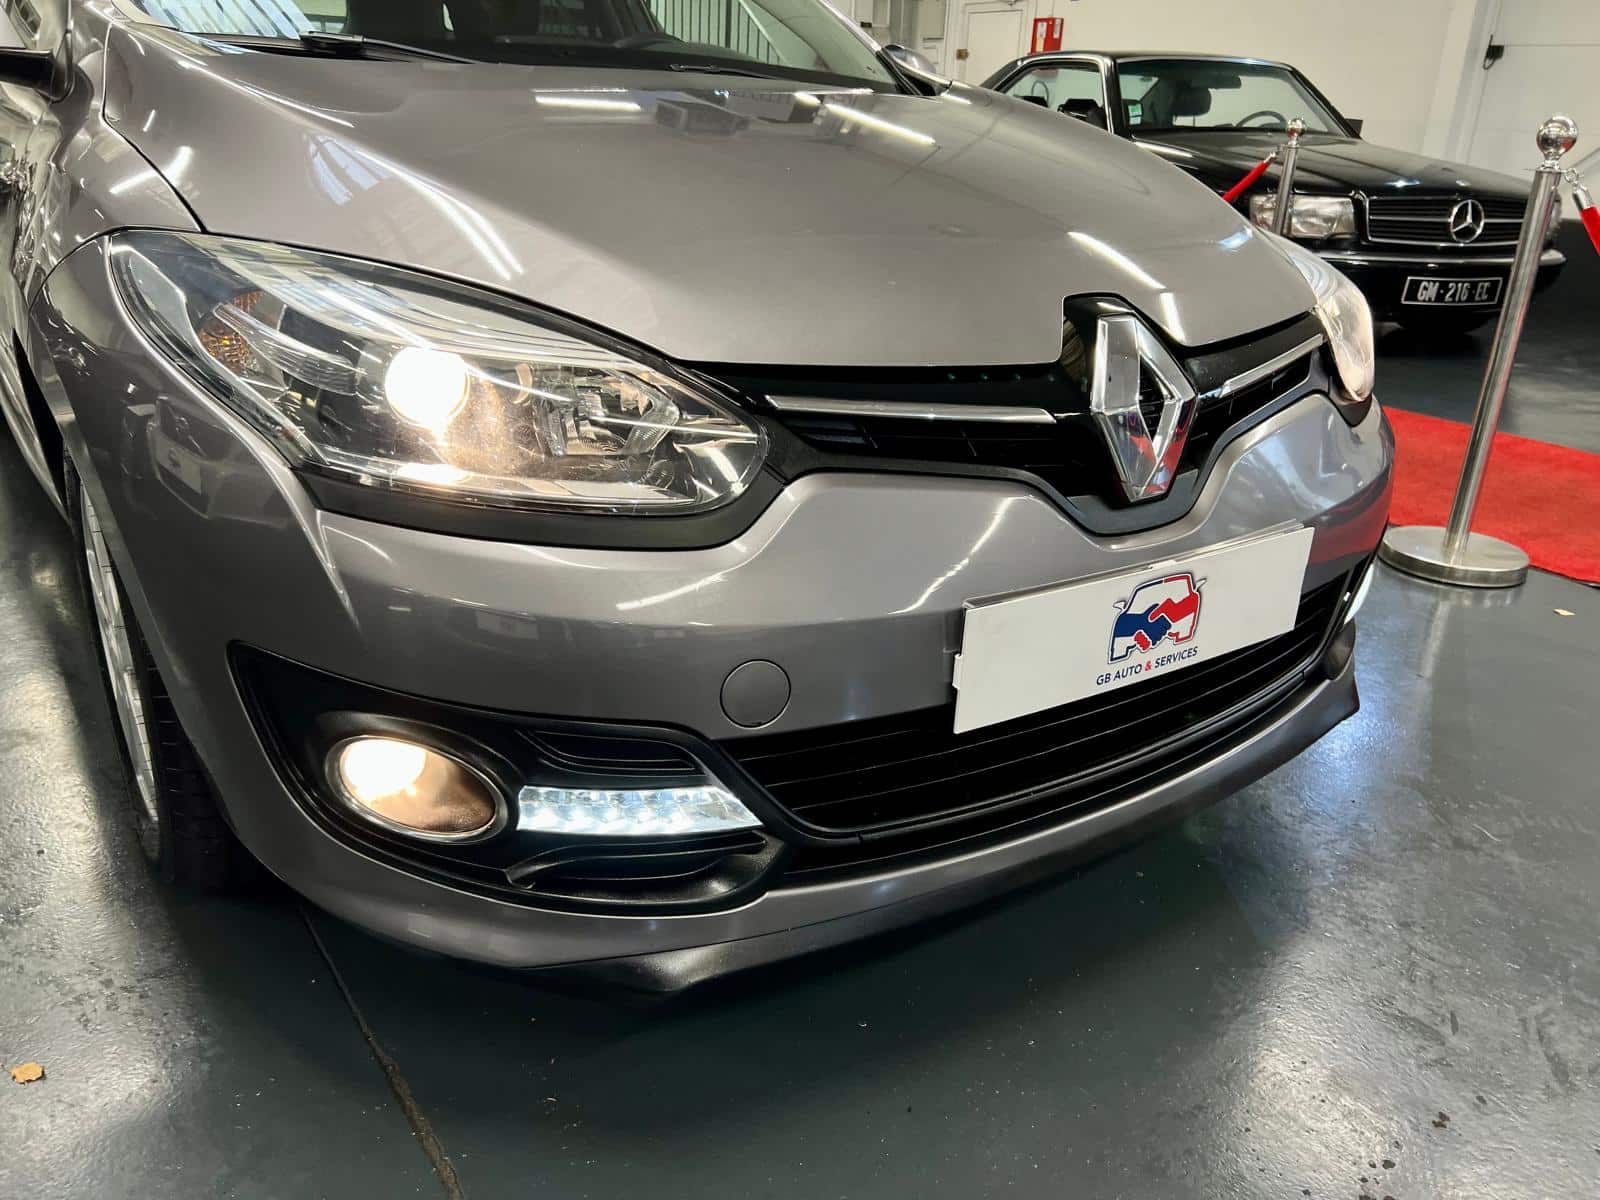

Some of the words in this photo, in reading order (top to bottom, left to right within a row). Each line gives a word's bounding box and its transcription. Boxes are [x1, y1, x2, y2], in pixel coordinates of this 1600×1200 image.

[1096, 673, 1111, 686] GB
[1113, 664, 1143, 681] AUTO
[1144, 660, 1152, 672] &
[1154, 646, 1198, 669] SERVICES
